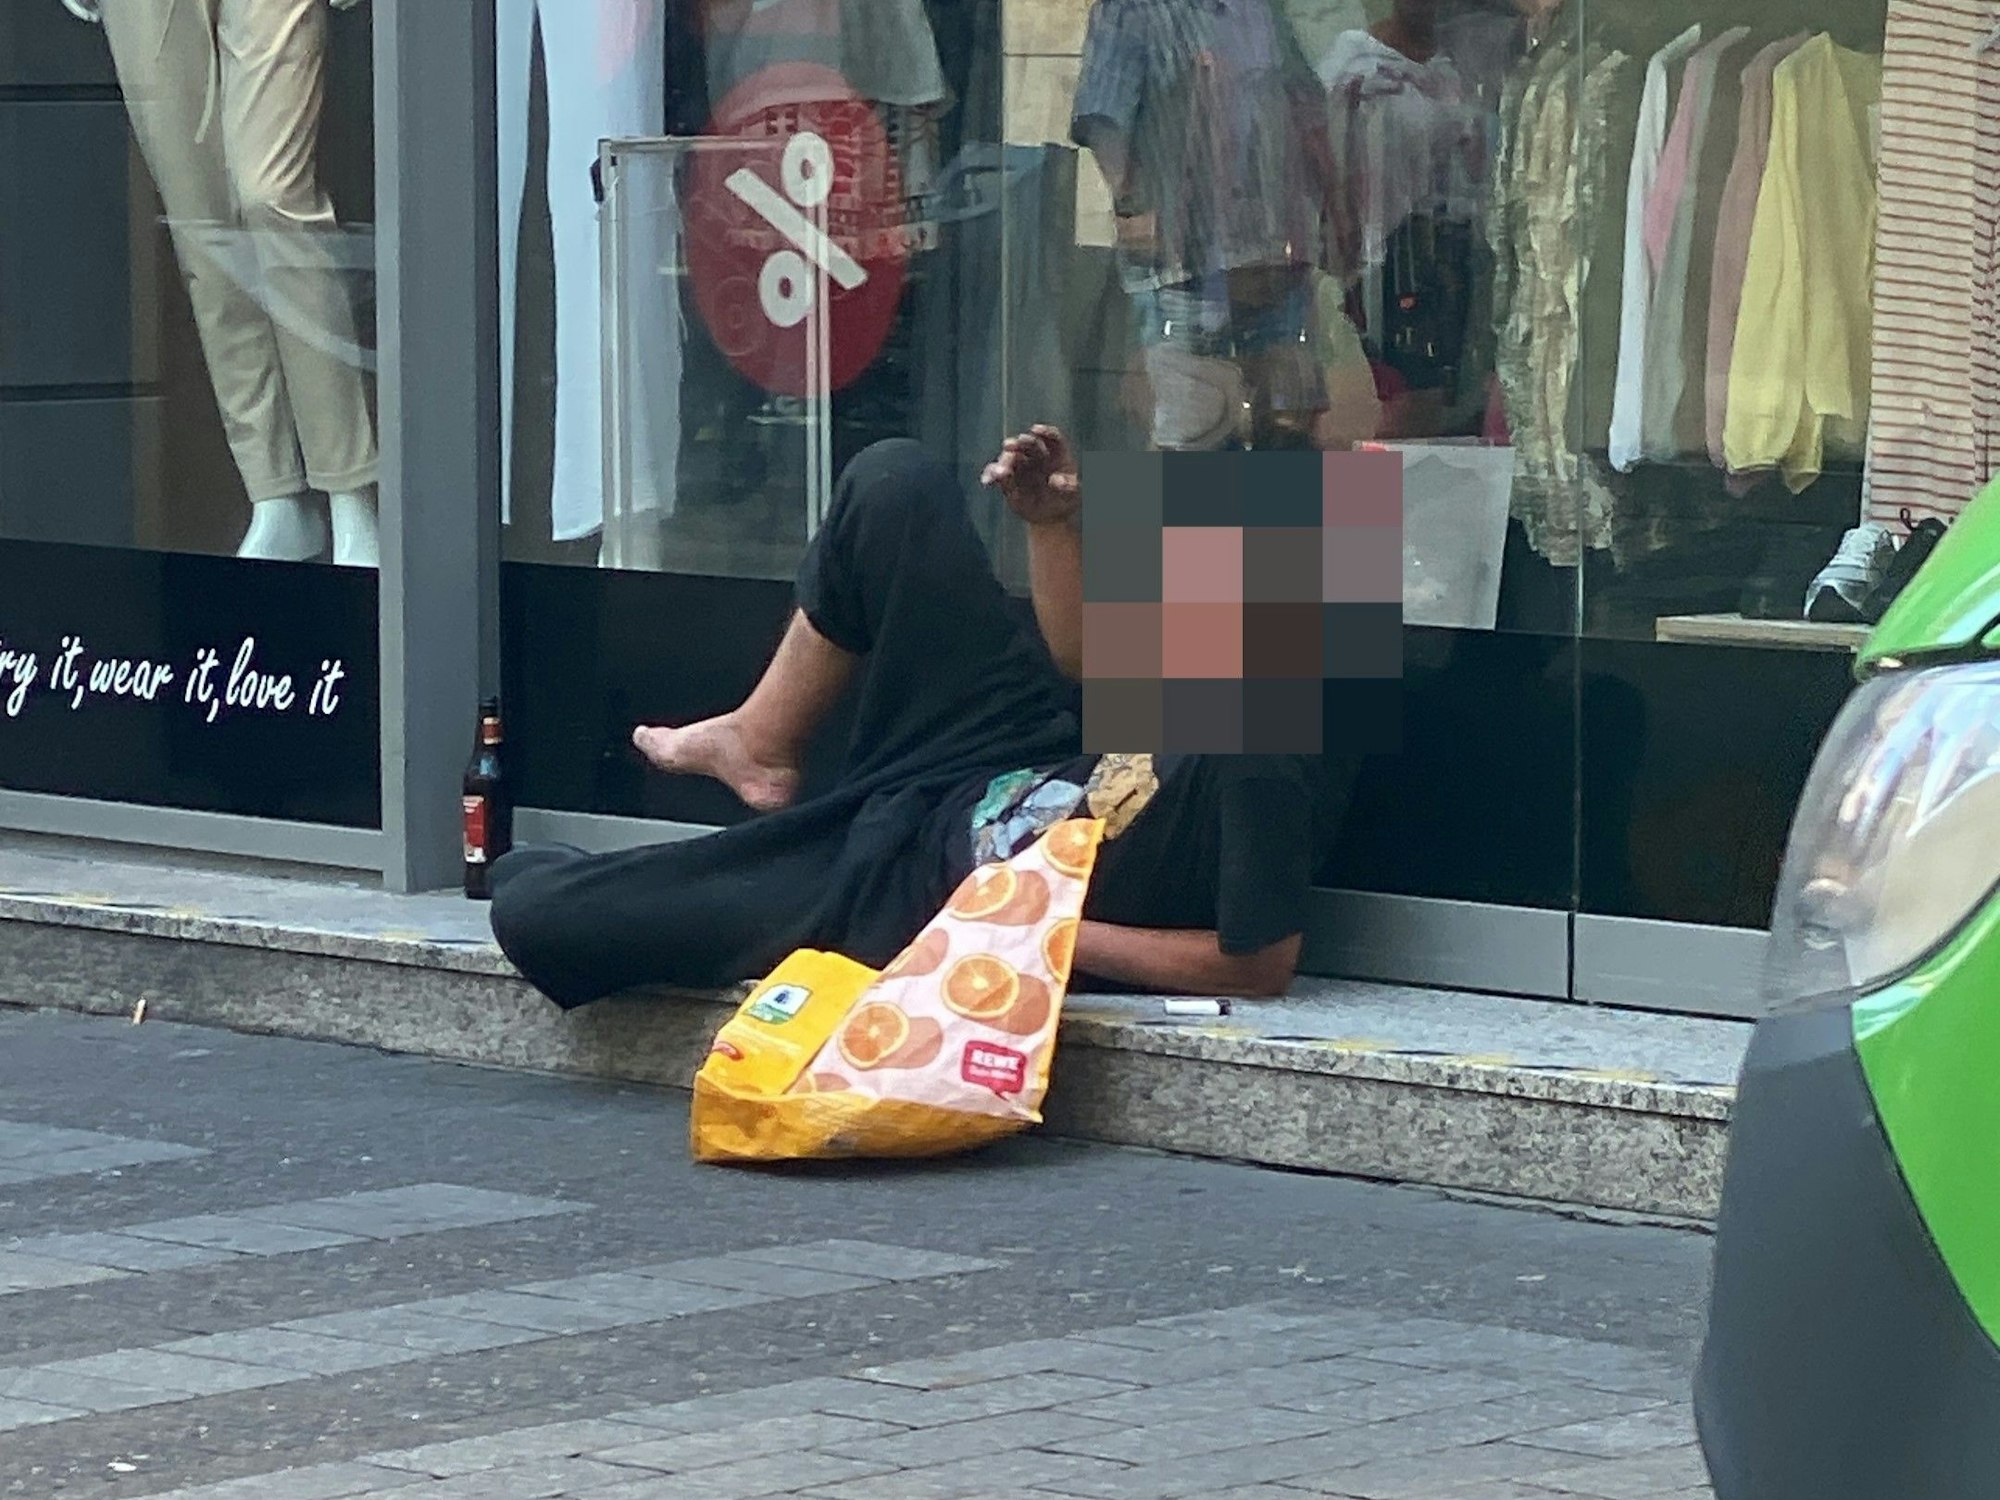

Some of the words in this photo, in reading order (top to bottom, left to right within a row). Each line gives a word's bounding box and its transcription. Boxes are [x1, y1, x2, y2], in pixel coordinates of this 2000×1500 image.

[724, 131, 869, 328] %
[0, 640, 38, 717] ry
[309, 660, 345, 715] it
